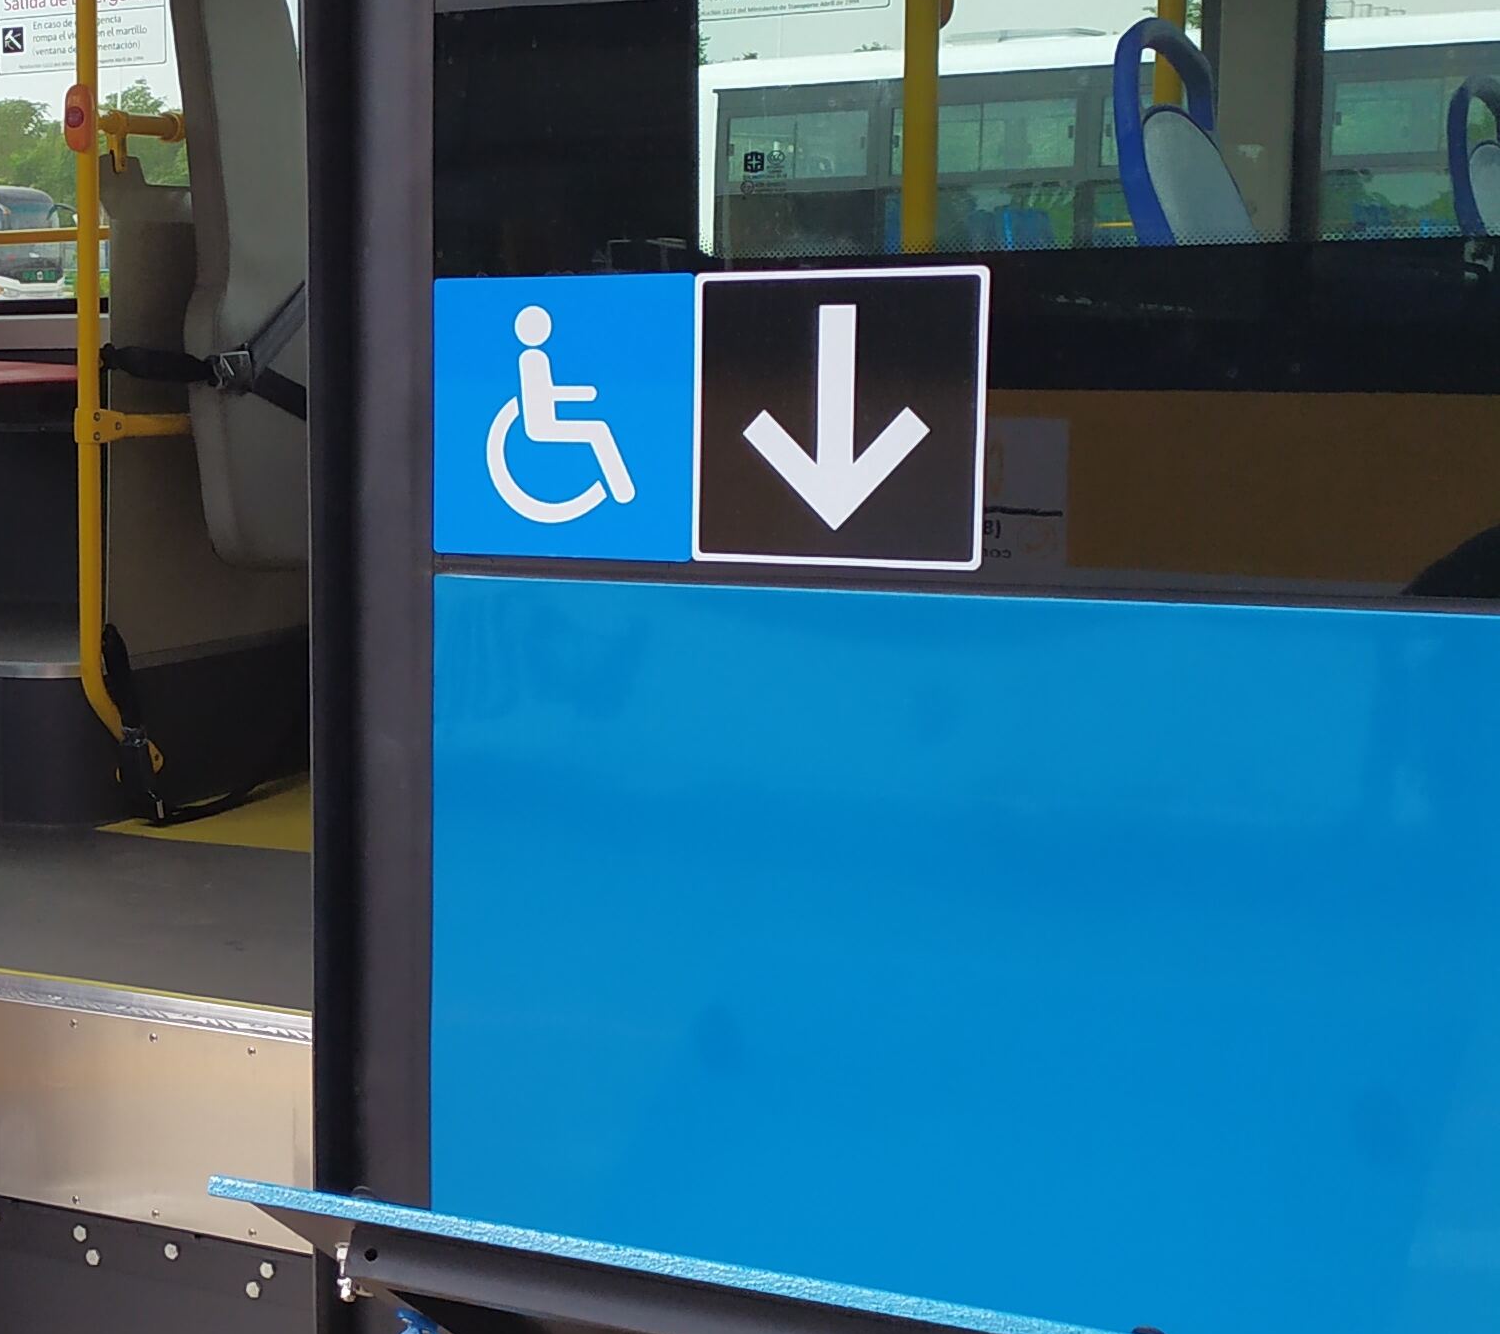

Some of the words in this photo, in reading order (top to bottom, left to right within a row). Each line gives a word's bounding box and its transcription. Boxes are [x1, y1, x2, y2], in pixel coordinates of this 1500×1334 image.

[33, 21, 43, 30] En
[44, 21, 62, 29] caso
[62, 18, 73, 28] de
[115, 25, 148, 35] martillo
[33, 34, 57, 43] rompa
